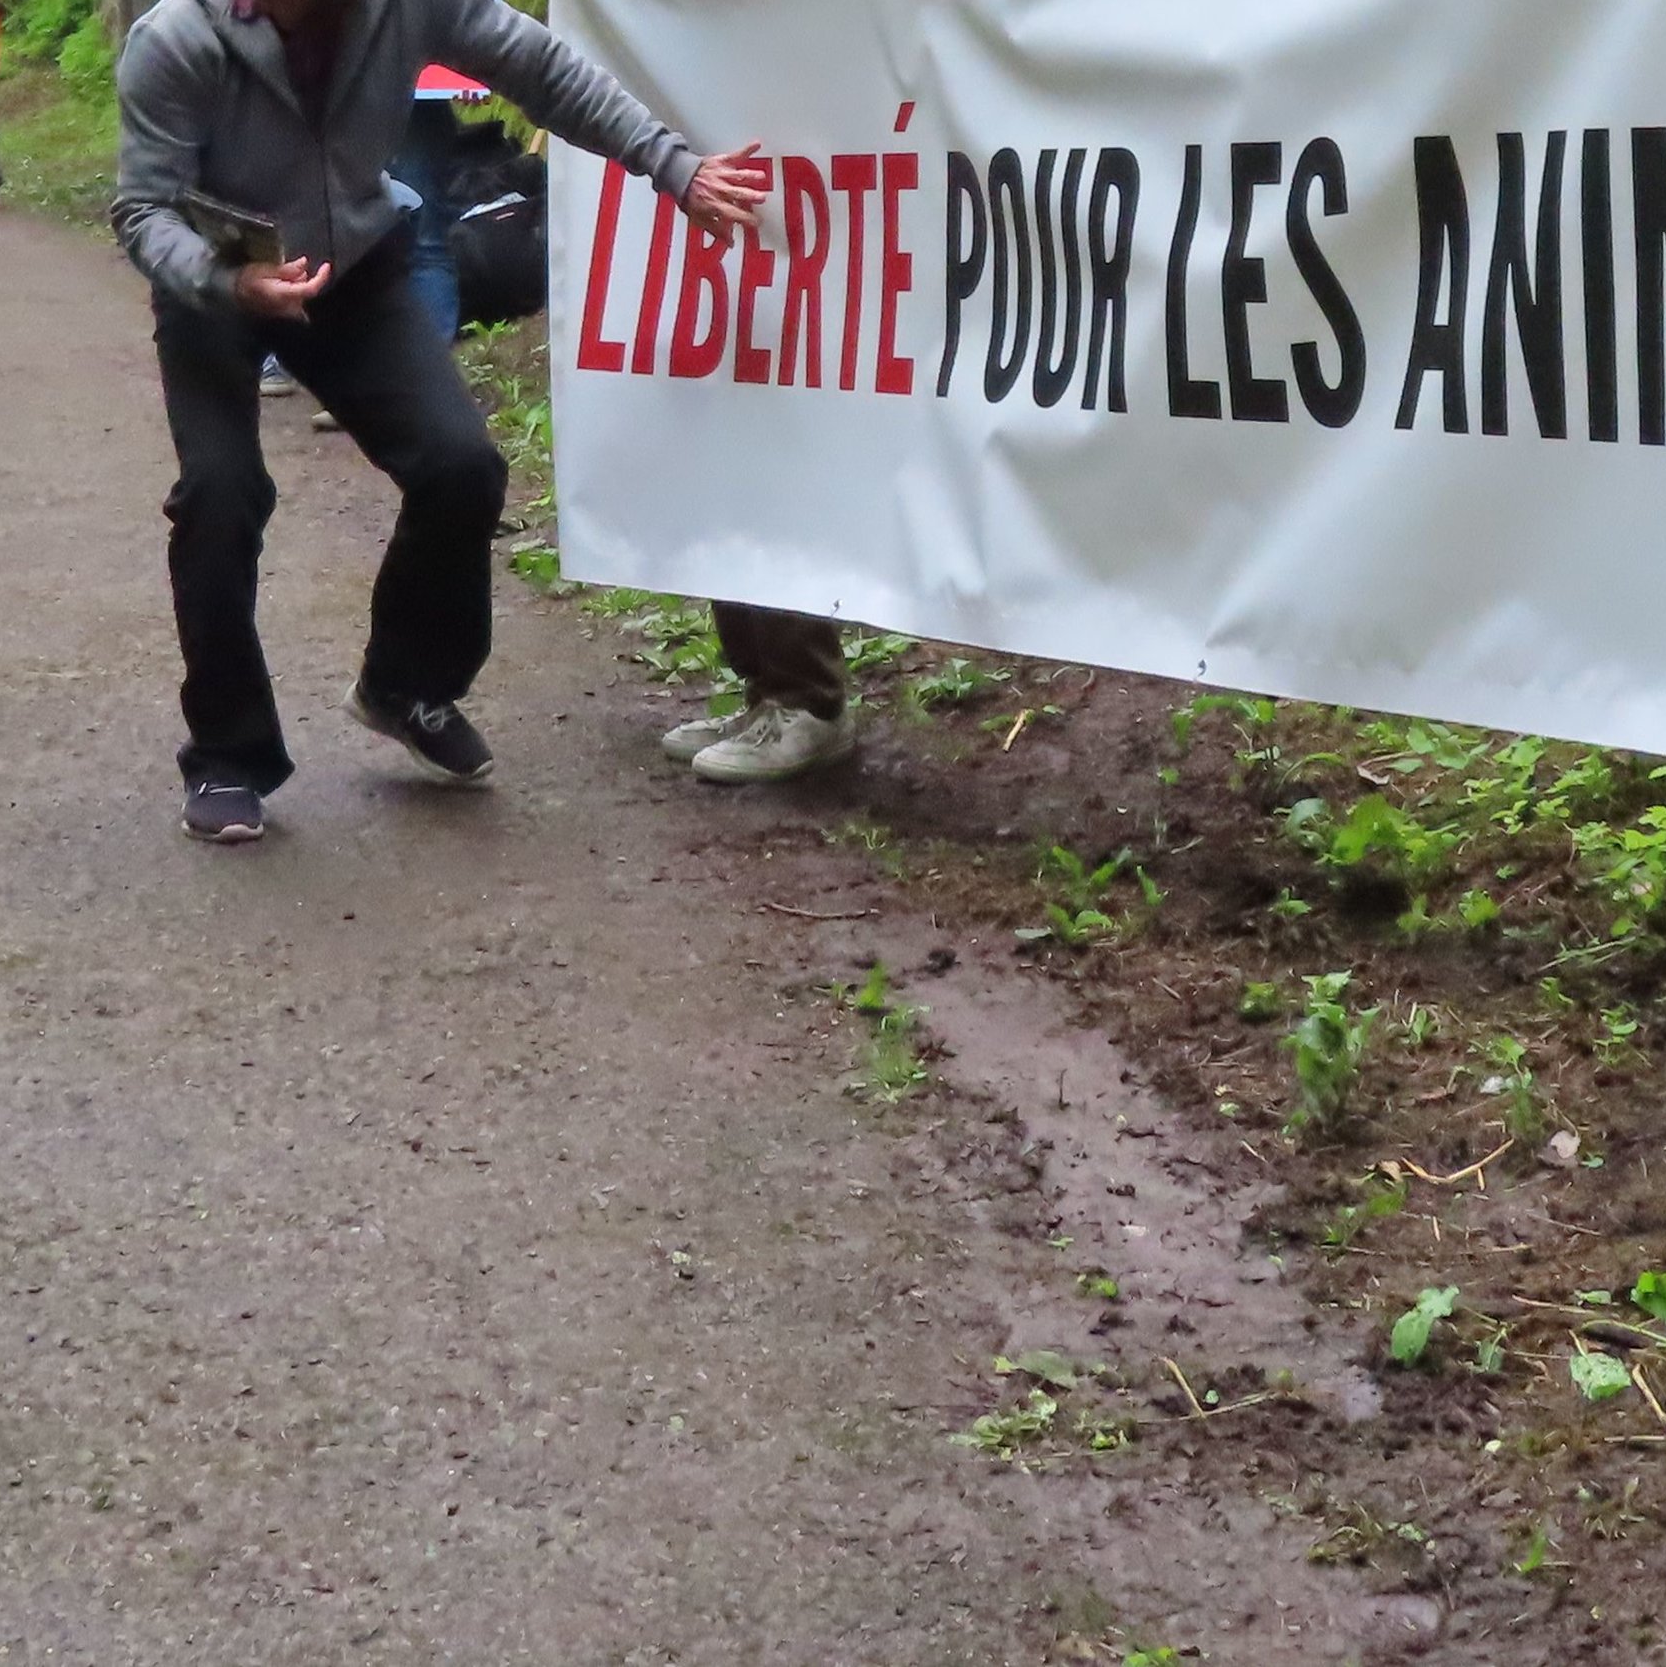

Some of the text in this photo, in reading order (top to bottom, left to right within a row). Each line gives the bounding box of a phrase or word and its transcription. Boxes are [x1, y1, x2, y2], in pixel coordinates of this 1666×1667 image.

[577, 101, 919, 396] LIBERTÉ
[937, 146, 1142, 414] POUR
[1166, 137, 1367, 429] LES
